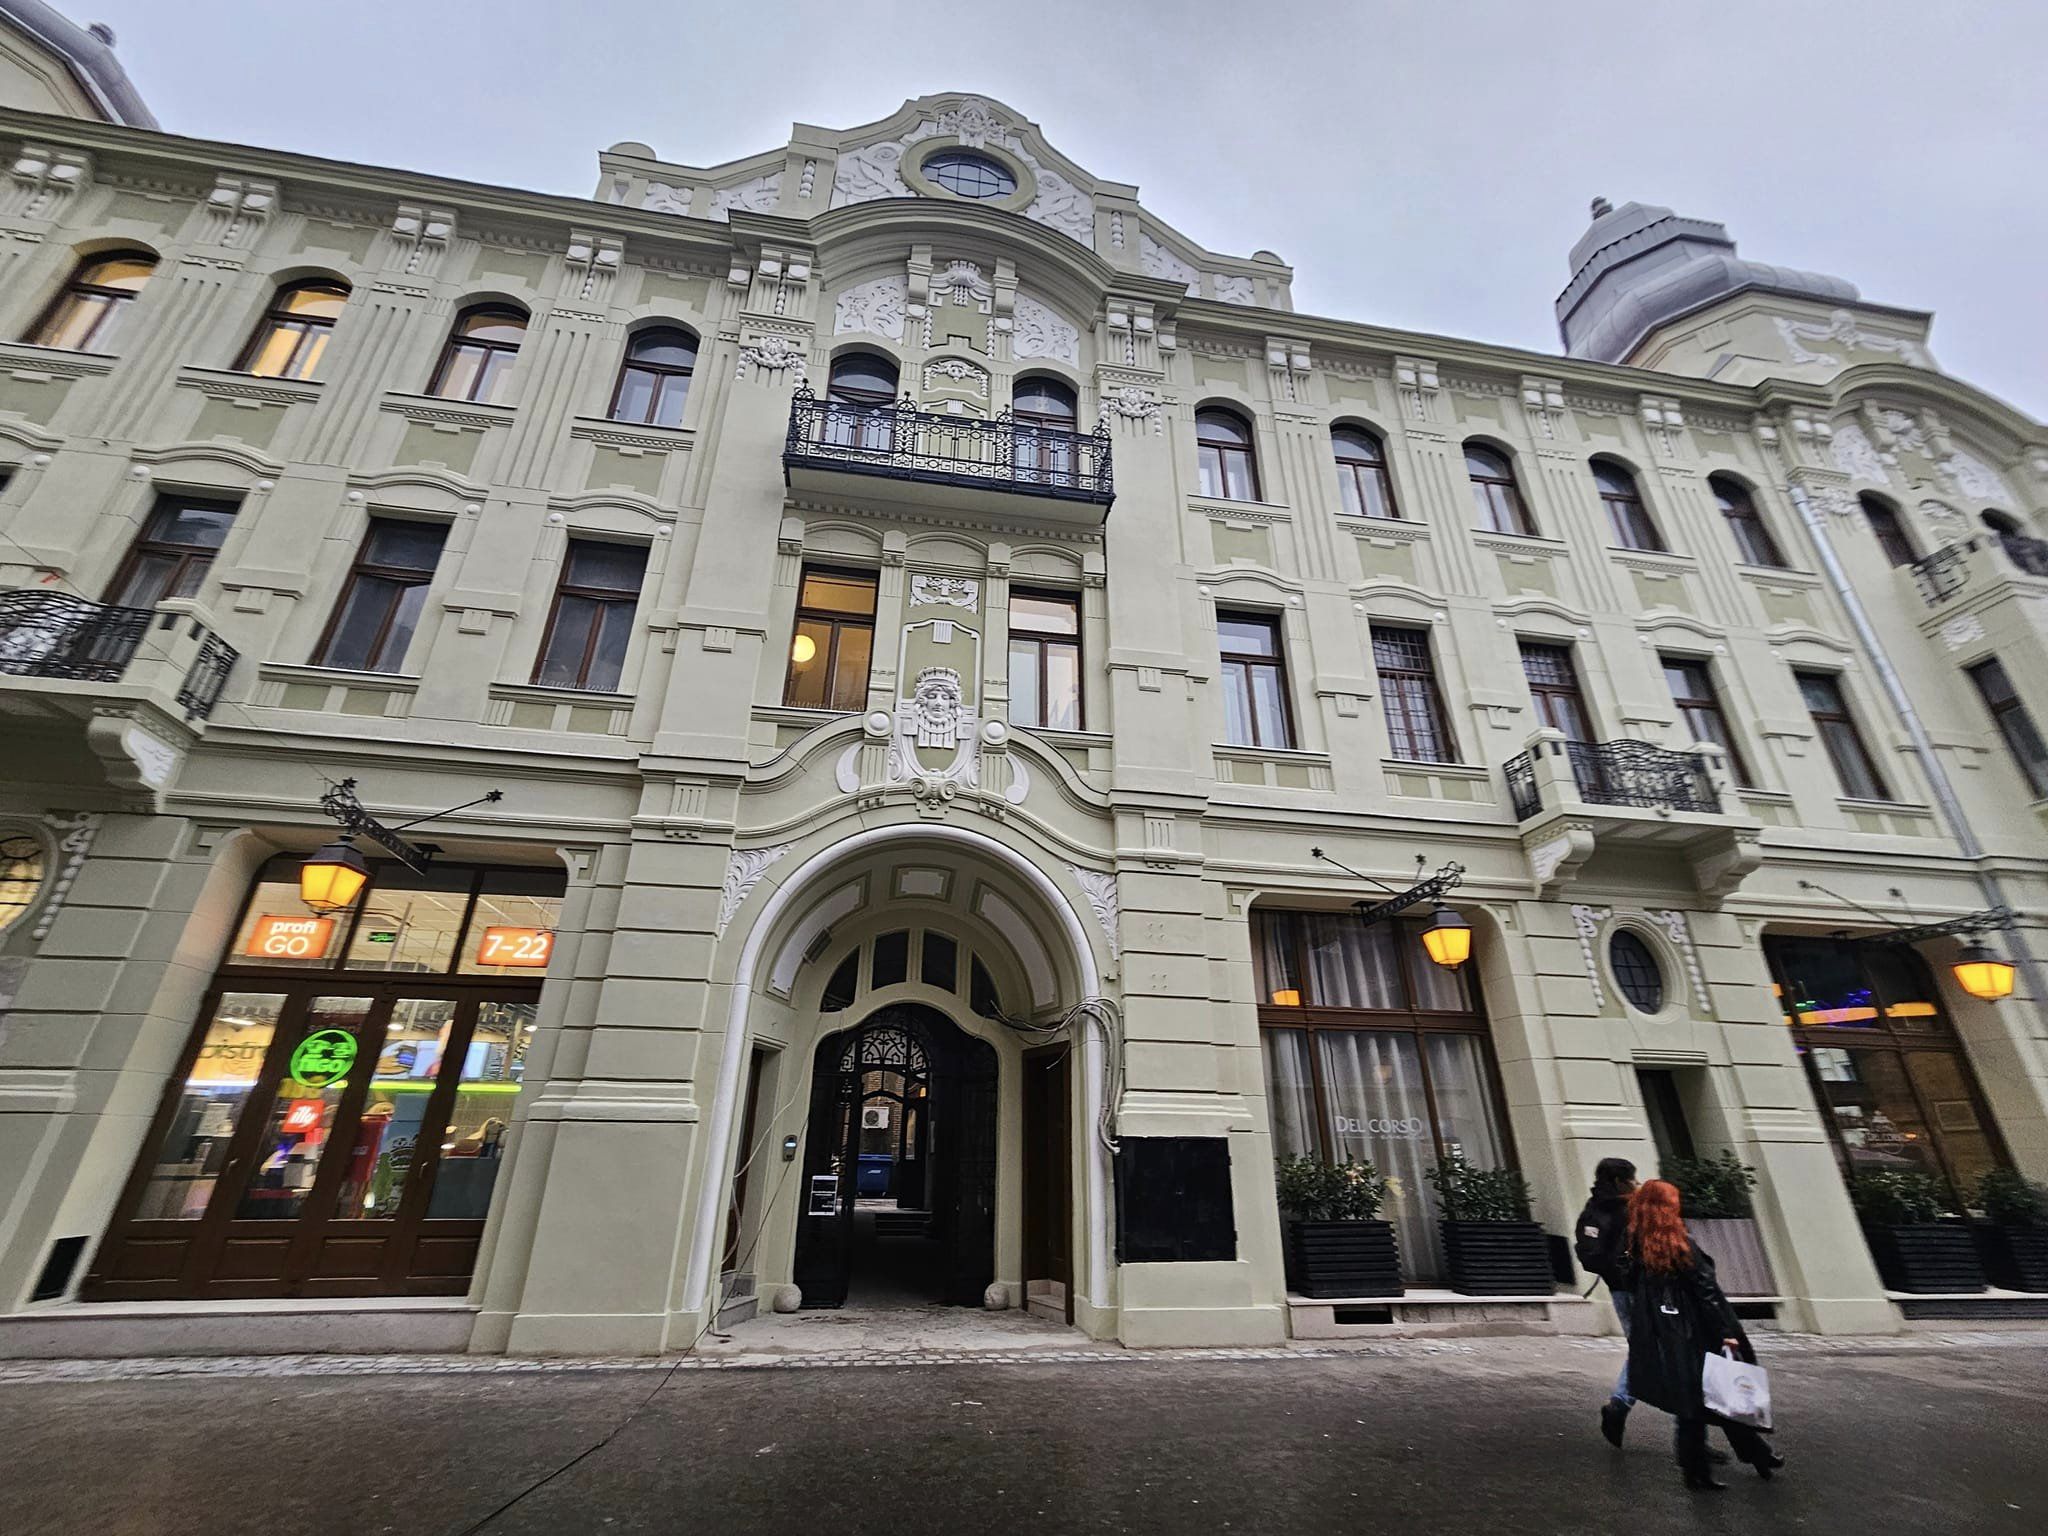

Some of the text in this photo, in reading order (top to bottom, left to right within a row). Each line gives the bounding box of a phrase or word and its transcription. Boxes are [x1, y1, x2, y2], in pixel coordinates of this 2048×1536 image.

[270, 921, 317, 935] profi
[264, 935, 309, 955] GO
[485, 935, 548, 959] 7-22
[1335, 1116, 1422, 1134] DEL CORSO
